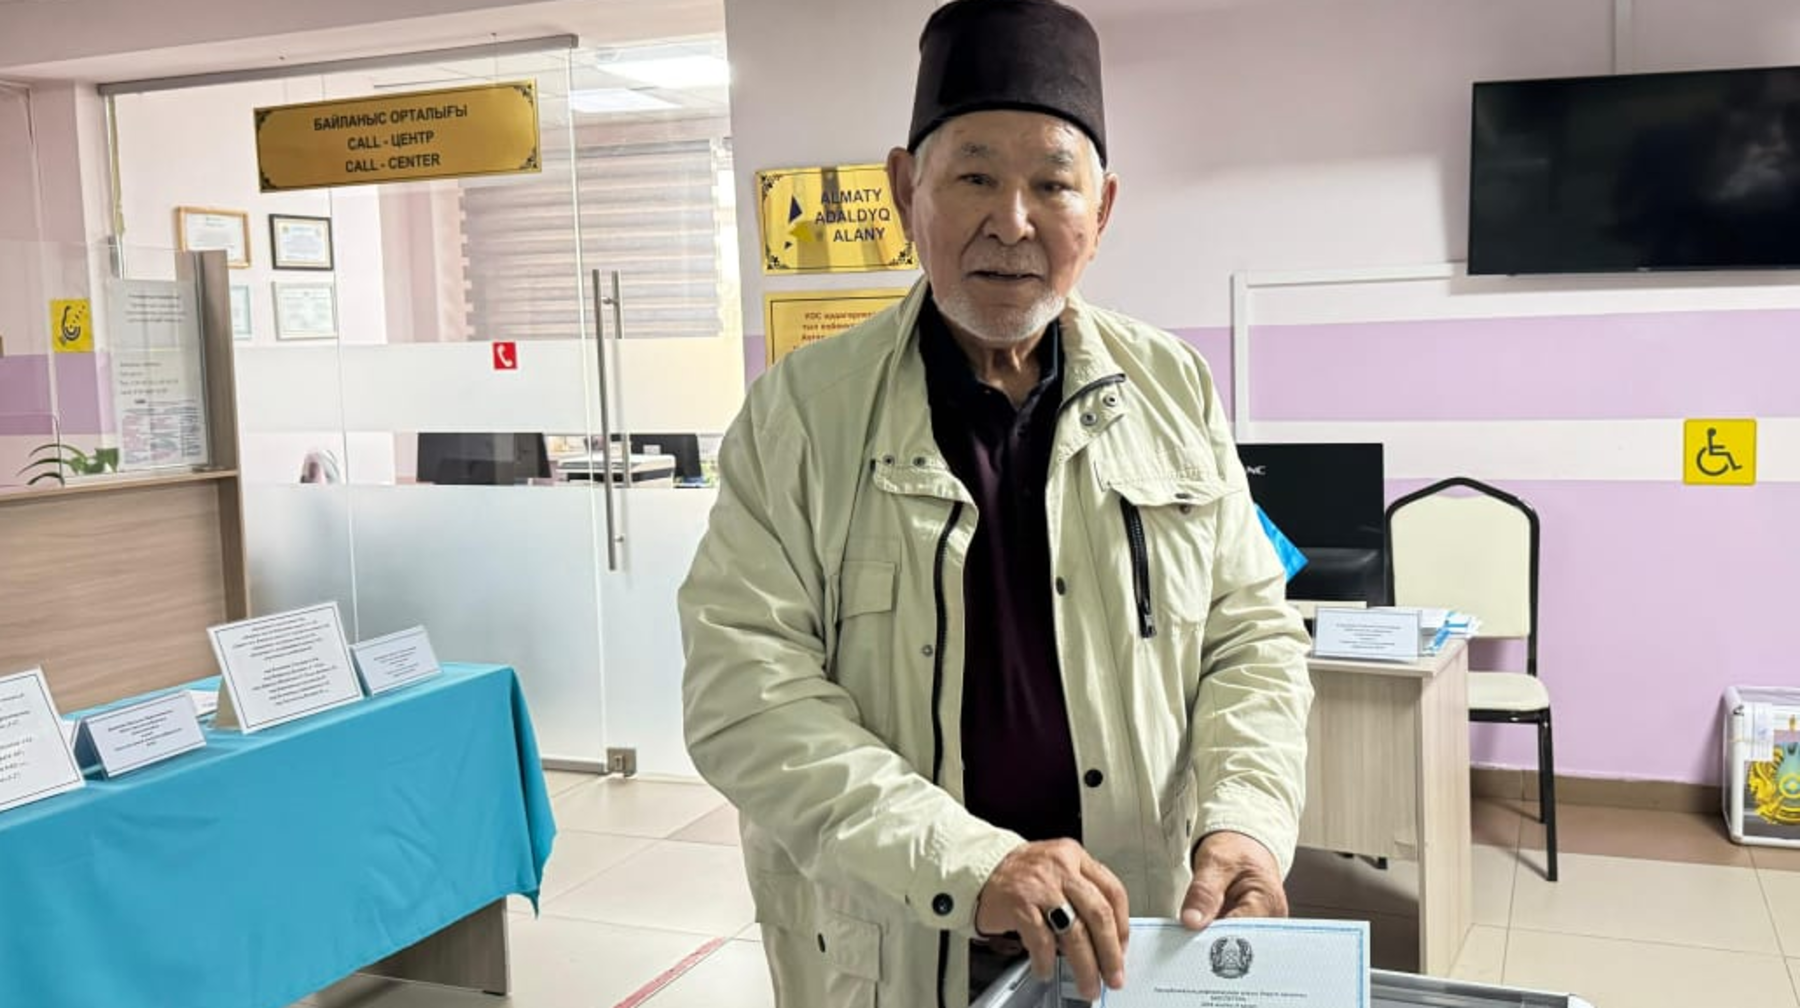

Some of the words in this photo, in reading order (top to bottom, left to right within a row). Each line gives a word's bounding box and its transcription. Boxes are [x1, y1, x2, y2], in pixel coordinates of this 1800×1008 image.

[314, 112, 387, 131] БАЙЛАНЫС
[390, 105, 467, 124] ОРТАЛЫҒЫ
[347, 135, 381, 151] CALL
[391, 131, 434, 149] ЦЕНТР
[345, 157, 379, 173] CALL
[388, 153, 440, 170] CENTER
[821, 188, 882, 205] ALMATY
[815, 208, 891, 224] ADALDYQ
[833, 226, 885, 242] ALANY
